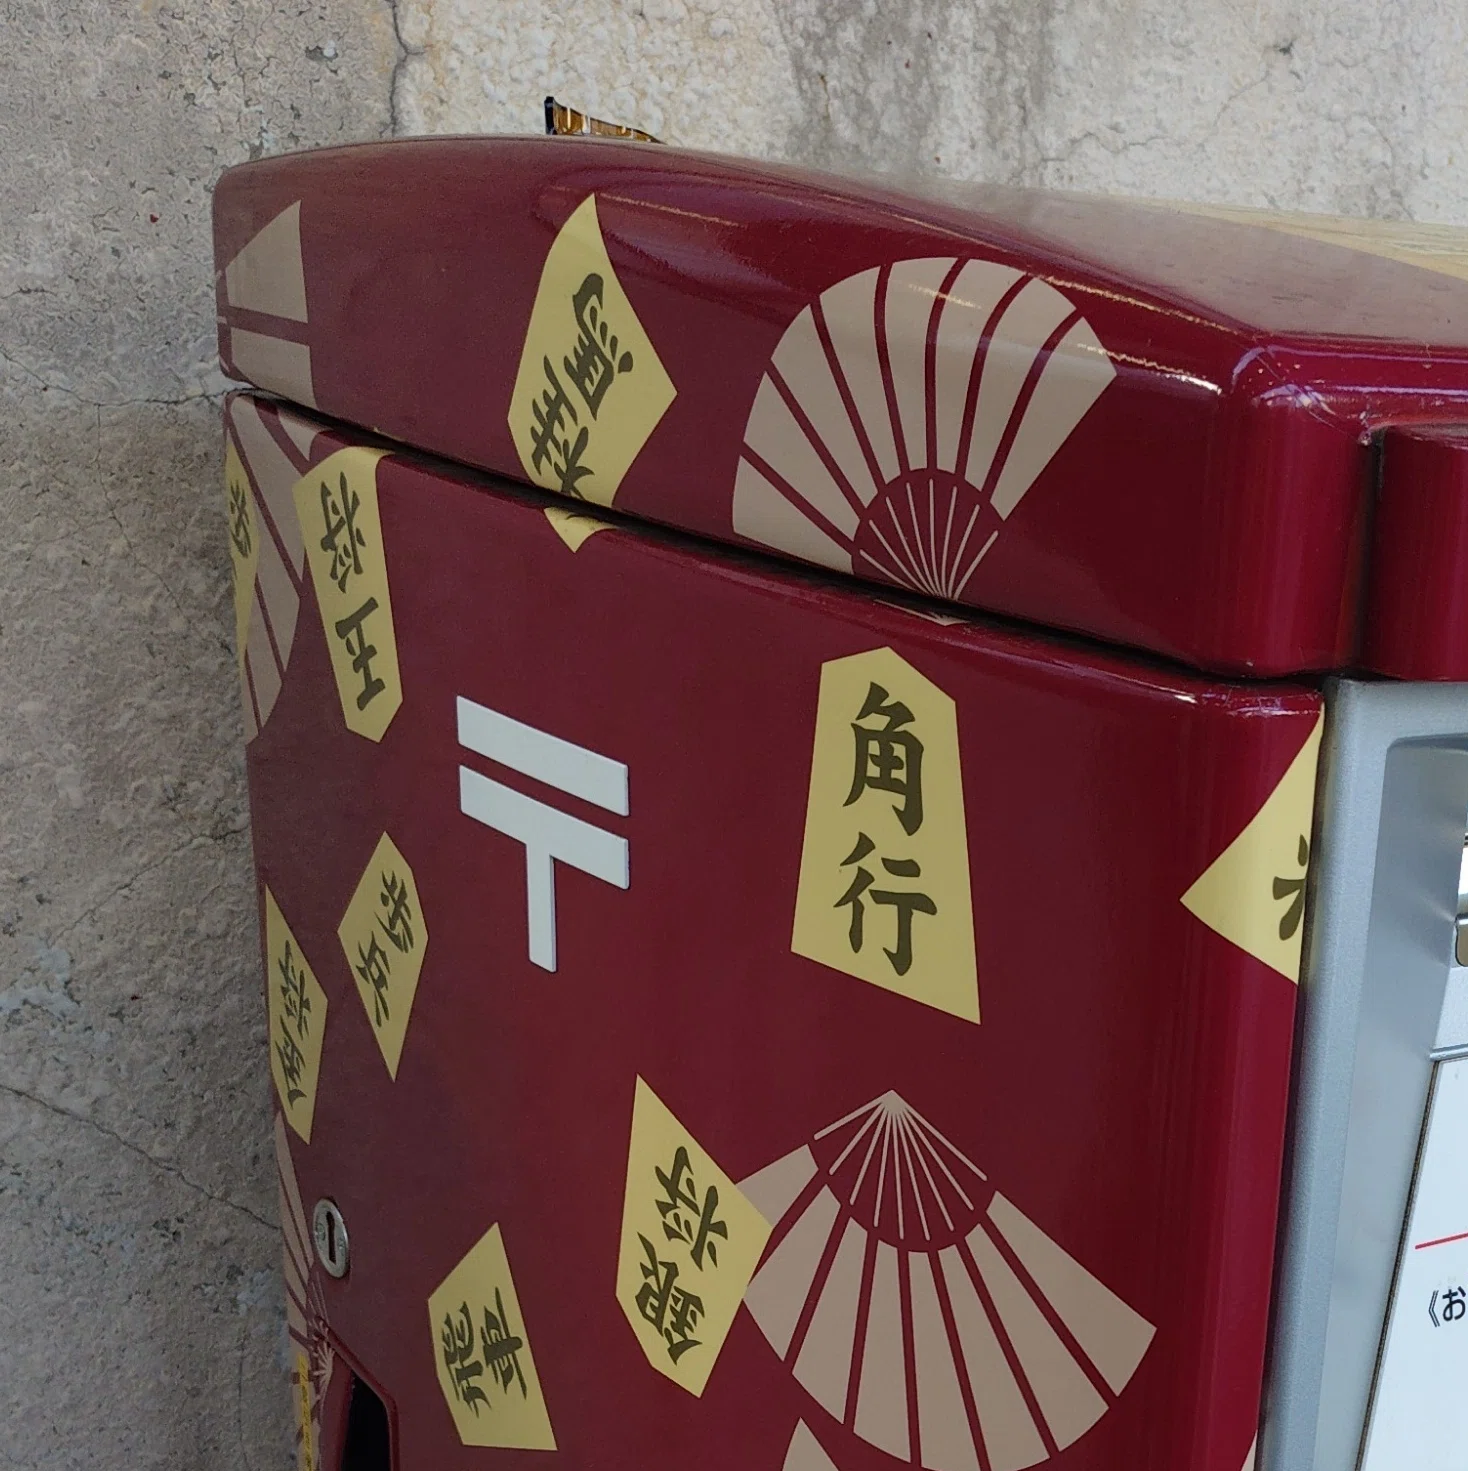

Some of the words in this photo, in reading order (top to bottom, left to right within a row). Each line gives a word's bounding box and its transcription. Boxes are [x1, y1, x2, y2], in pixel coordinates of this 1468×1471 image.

[833, 680, 938, 977] 角行
[355, 869, 415, 1028] 歩兵
[635, 1146, 728, 1365] 銀将
[443, 1286, 525, 1420] 飛車
